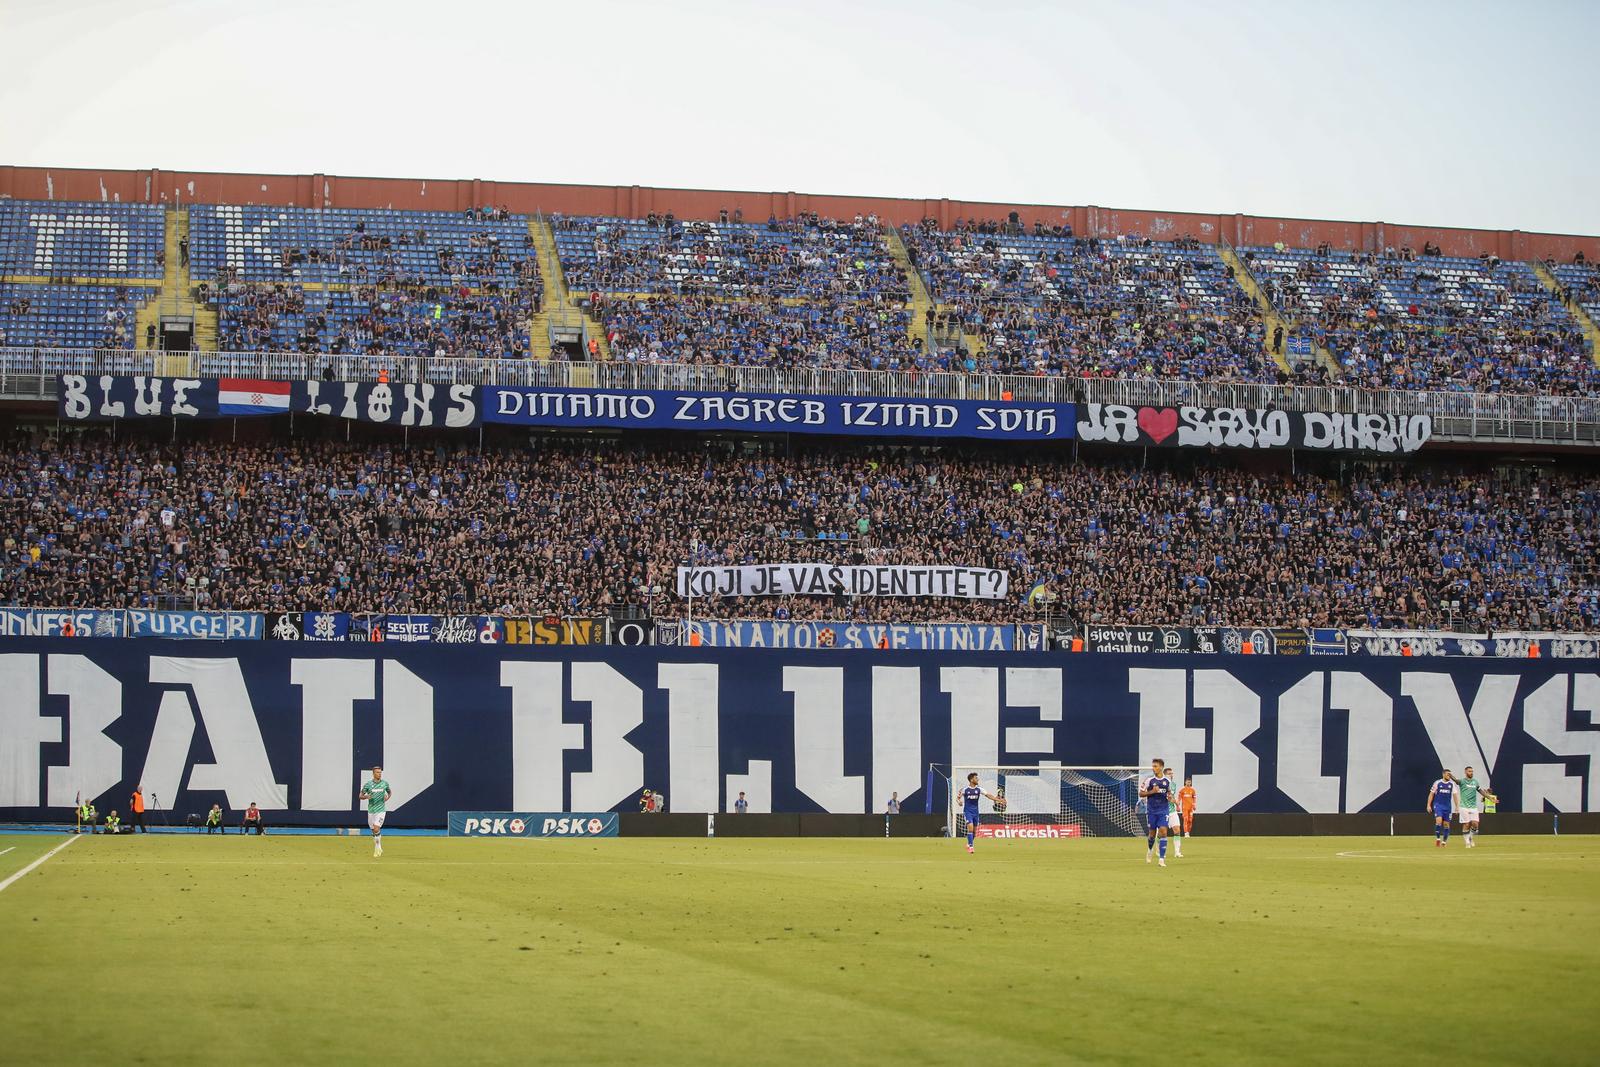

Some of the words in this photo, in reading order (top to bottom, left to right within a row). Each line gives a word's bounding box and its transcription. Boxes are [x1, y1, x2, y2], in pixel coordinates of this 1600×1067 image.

[62, 375, 201, 419] BLUE
[306, 380, 476, 428] LIONS
[498, 390, 656, 418] DINAMO
[673, 396, 826, 425] ZAGREB
[841, 402, 958, 428] IZNAD
[1077, 403, 1138, 443] JA
[1178, 406, 1291, 448] SAMO
[1303, 412, 1432, 452] DINAMO
[684, 569, 742, 596] KOJI
[750, 566, 783, 595] JE
[851, 567, 1003, 598] IDENTITET?
[129, 610, 258, 639] PURGERI
[387, 623, 429, 633] SESVETE
[505, 620, 592, 645] BSN
[683, 620, 809, 648] DINAMO
[846, 624, 1006, 650] SVETINJA
[1138, 631, 1154, 642] uz
[1495, 638, 1541, 658] BLU
[0, 652, 434, 812] BAD
[500, 660, 1062, 814] BLUE
[1128, 667, 1600, 814] BOYS
[464, 818, 509, 834] PSK
[542, 818, 587, 834] PSK
[994, 824, 1058, 839] aircash
